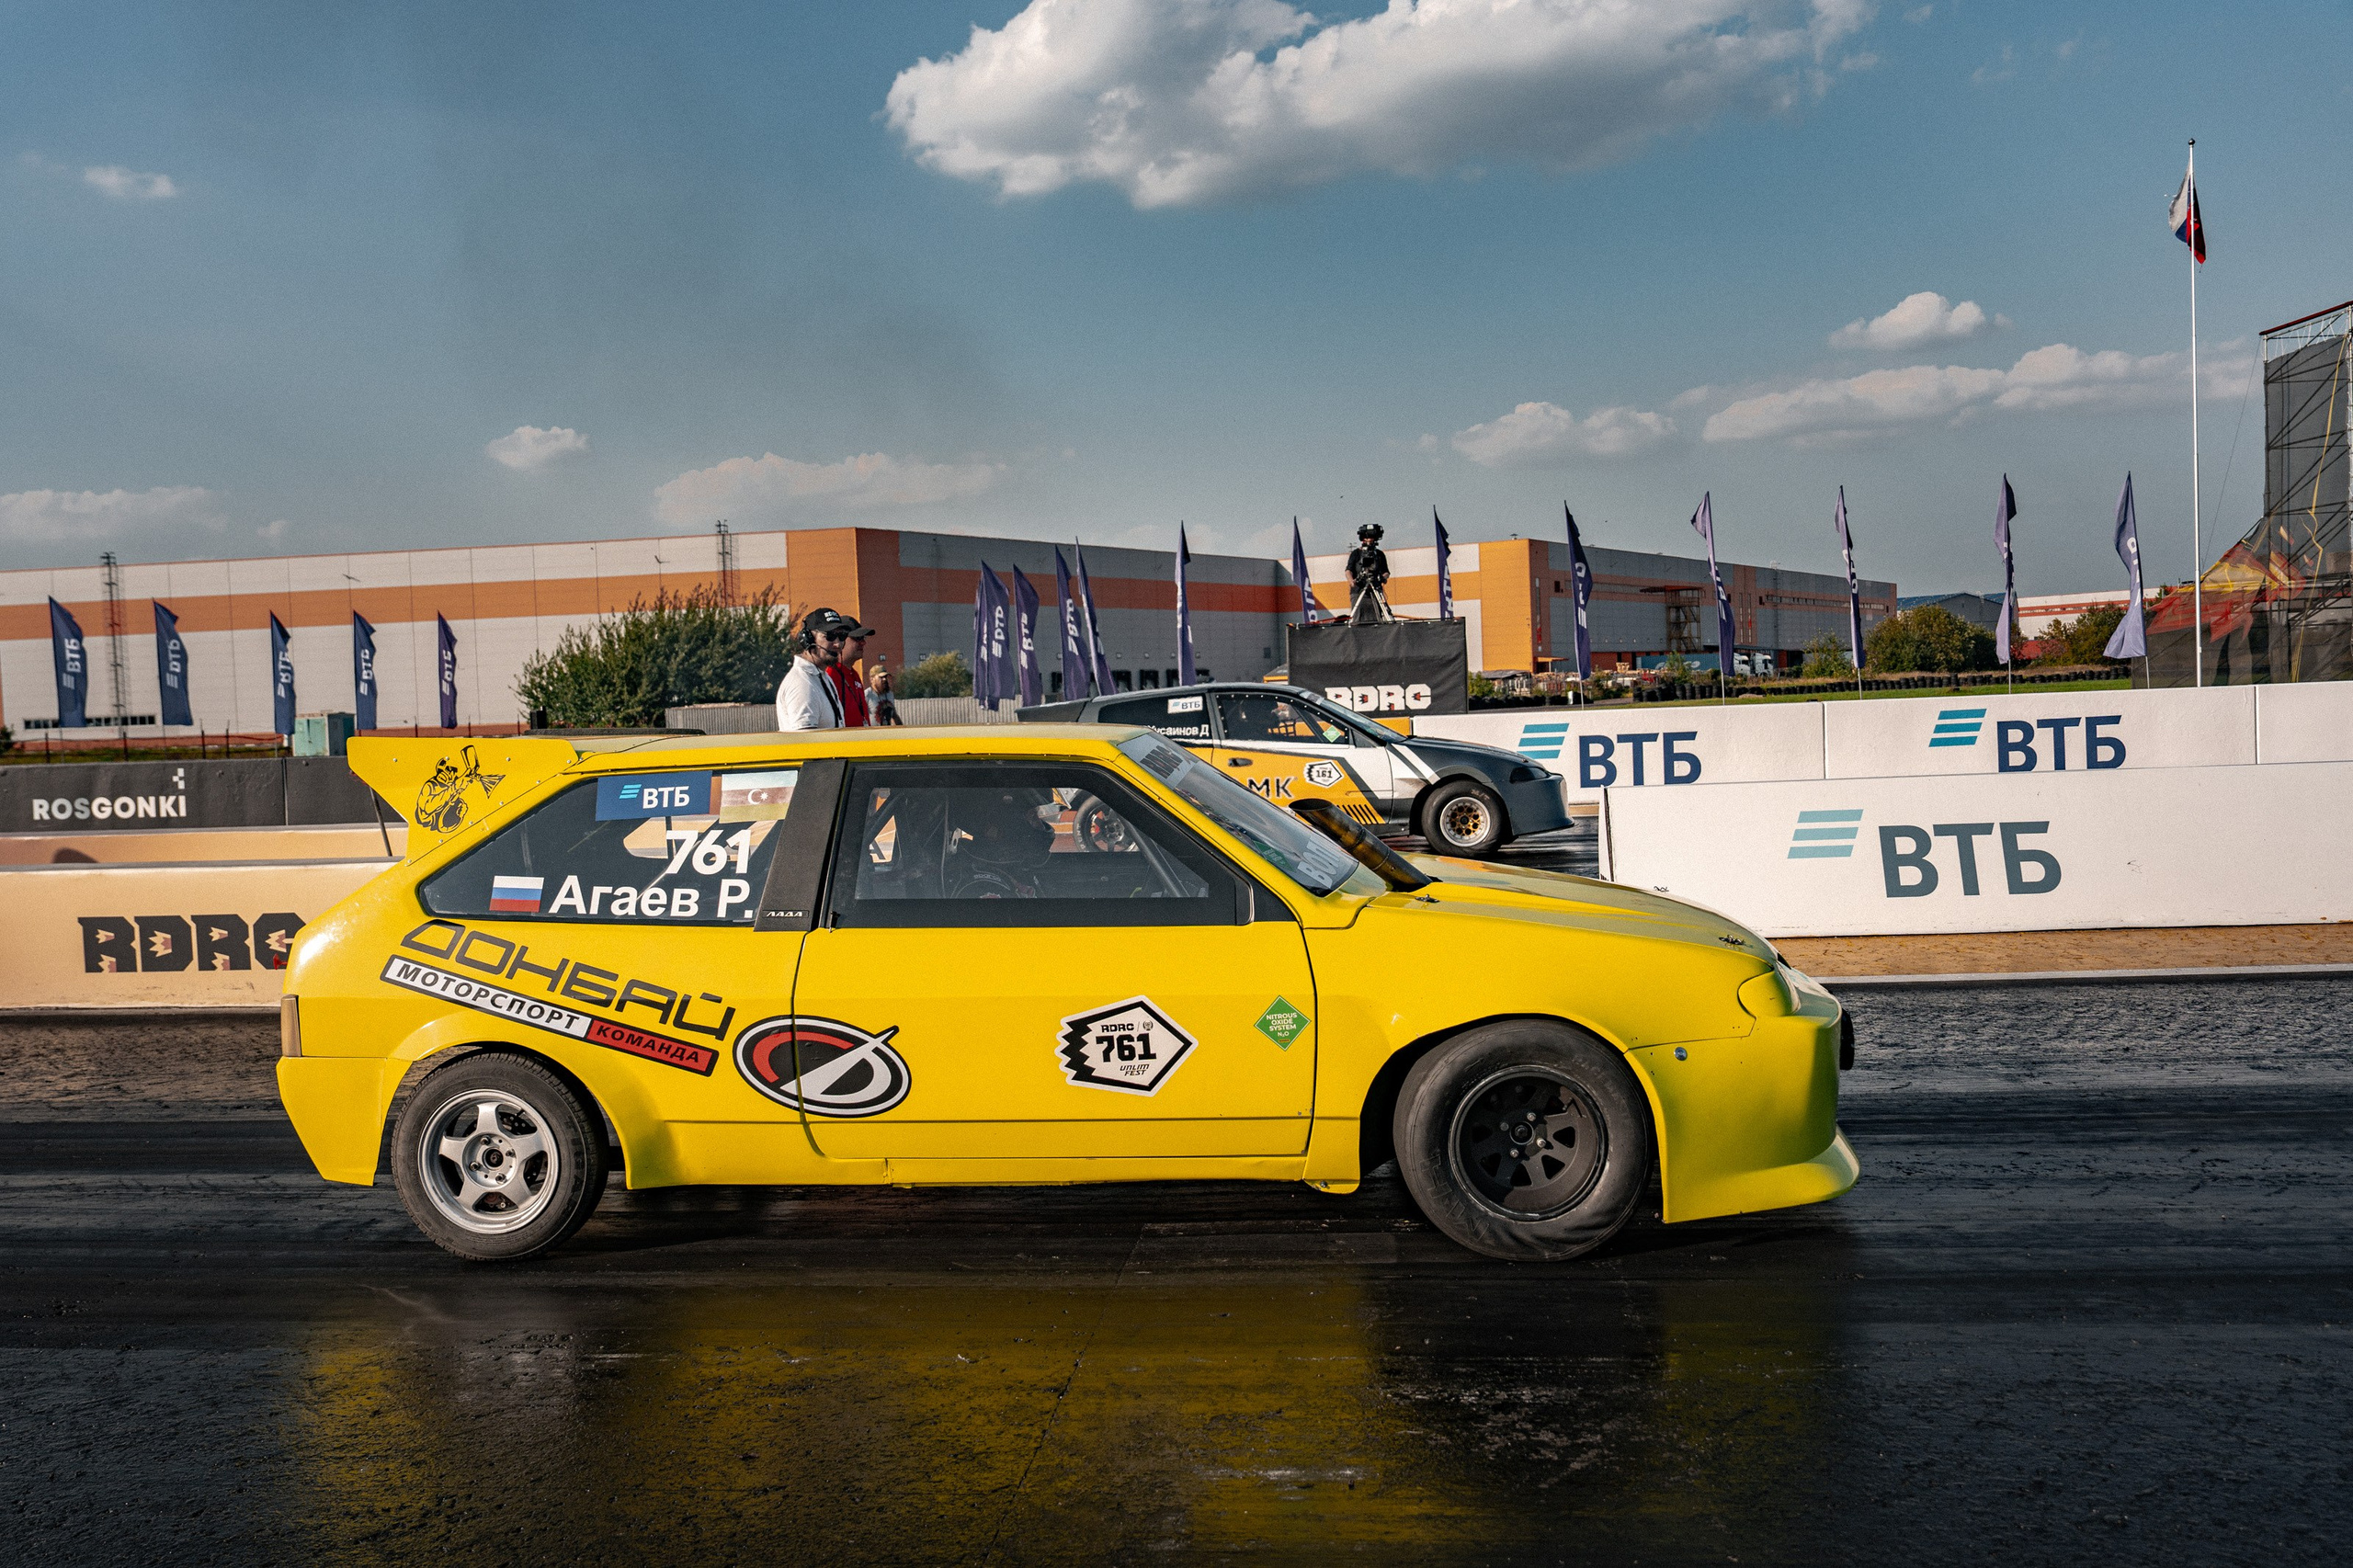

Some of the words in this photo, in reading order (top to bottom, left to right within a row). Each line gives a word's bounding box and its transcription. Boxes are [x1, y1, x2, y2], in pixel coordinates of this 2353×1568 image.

[64, 638, 81, 673] ВТБ
[1181, 700, 1200, 710] ВТБ
[1324, 684, 1431, 711] RDRC
[1579, 731, 1701, 789] ВТБ
[1998, 714, 2126, 772] ВТБ
[642, 786, 689, 809] ВТБ
[665, 829, 751, 875] 761
[1879, 821, 2063, 899] ВТБ
[548, 874, 699, 917] Агаев
[716, 879, 754, 919] Р.
[78, 912, 306, 973] RDRC
[400, 919, 736, 1041] ДОНБАЙ
[395, 962, 581, 1031] МОТОРСПОРТ
[596, 1025, 701, 1065] КОМАНДА
[1100, 1023, 1135, 1033] RDRC
[1266, 1012, 1298, 1020] NITROUS
[1096, 1033, 1157, 1062] 761
[1120, 1063, 1150, 1072] UNLIM
